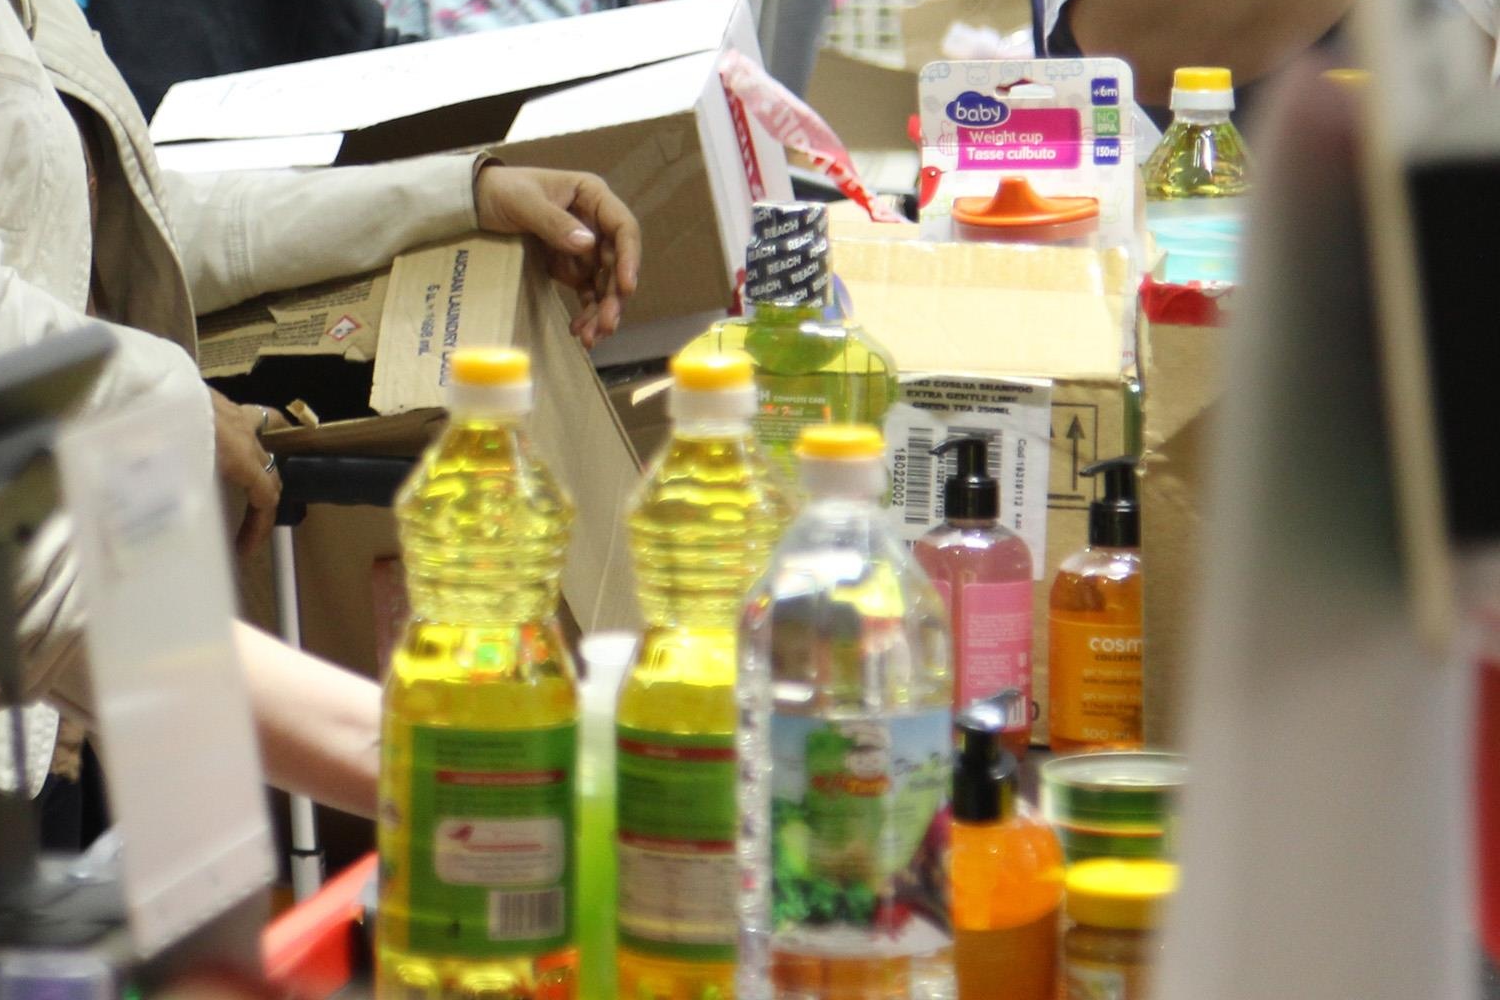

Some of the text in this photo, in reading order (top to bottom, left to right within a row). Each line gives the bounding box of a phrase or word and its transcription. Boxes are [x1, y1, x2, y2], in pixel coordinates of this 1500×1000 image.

[956, 101, 1001, 122] baby
[969, 130, 1044, 146] Weight cup
[966, 146, 1057, 160] Tasse culbuto
[764, 219, 799, 240] REACH
[787, 230, 815, 251] REACH
[451, 250, 468, 292] AUCHAN
[766, 255, 802, 275] REACH
[790, 261, 820, 284] REACH
[444, 294, 462, 347] LAUNDRY
[906, 390, 944, 399] EXTRA
